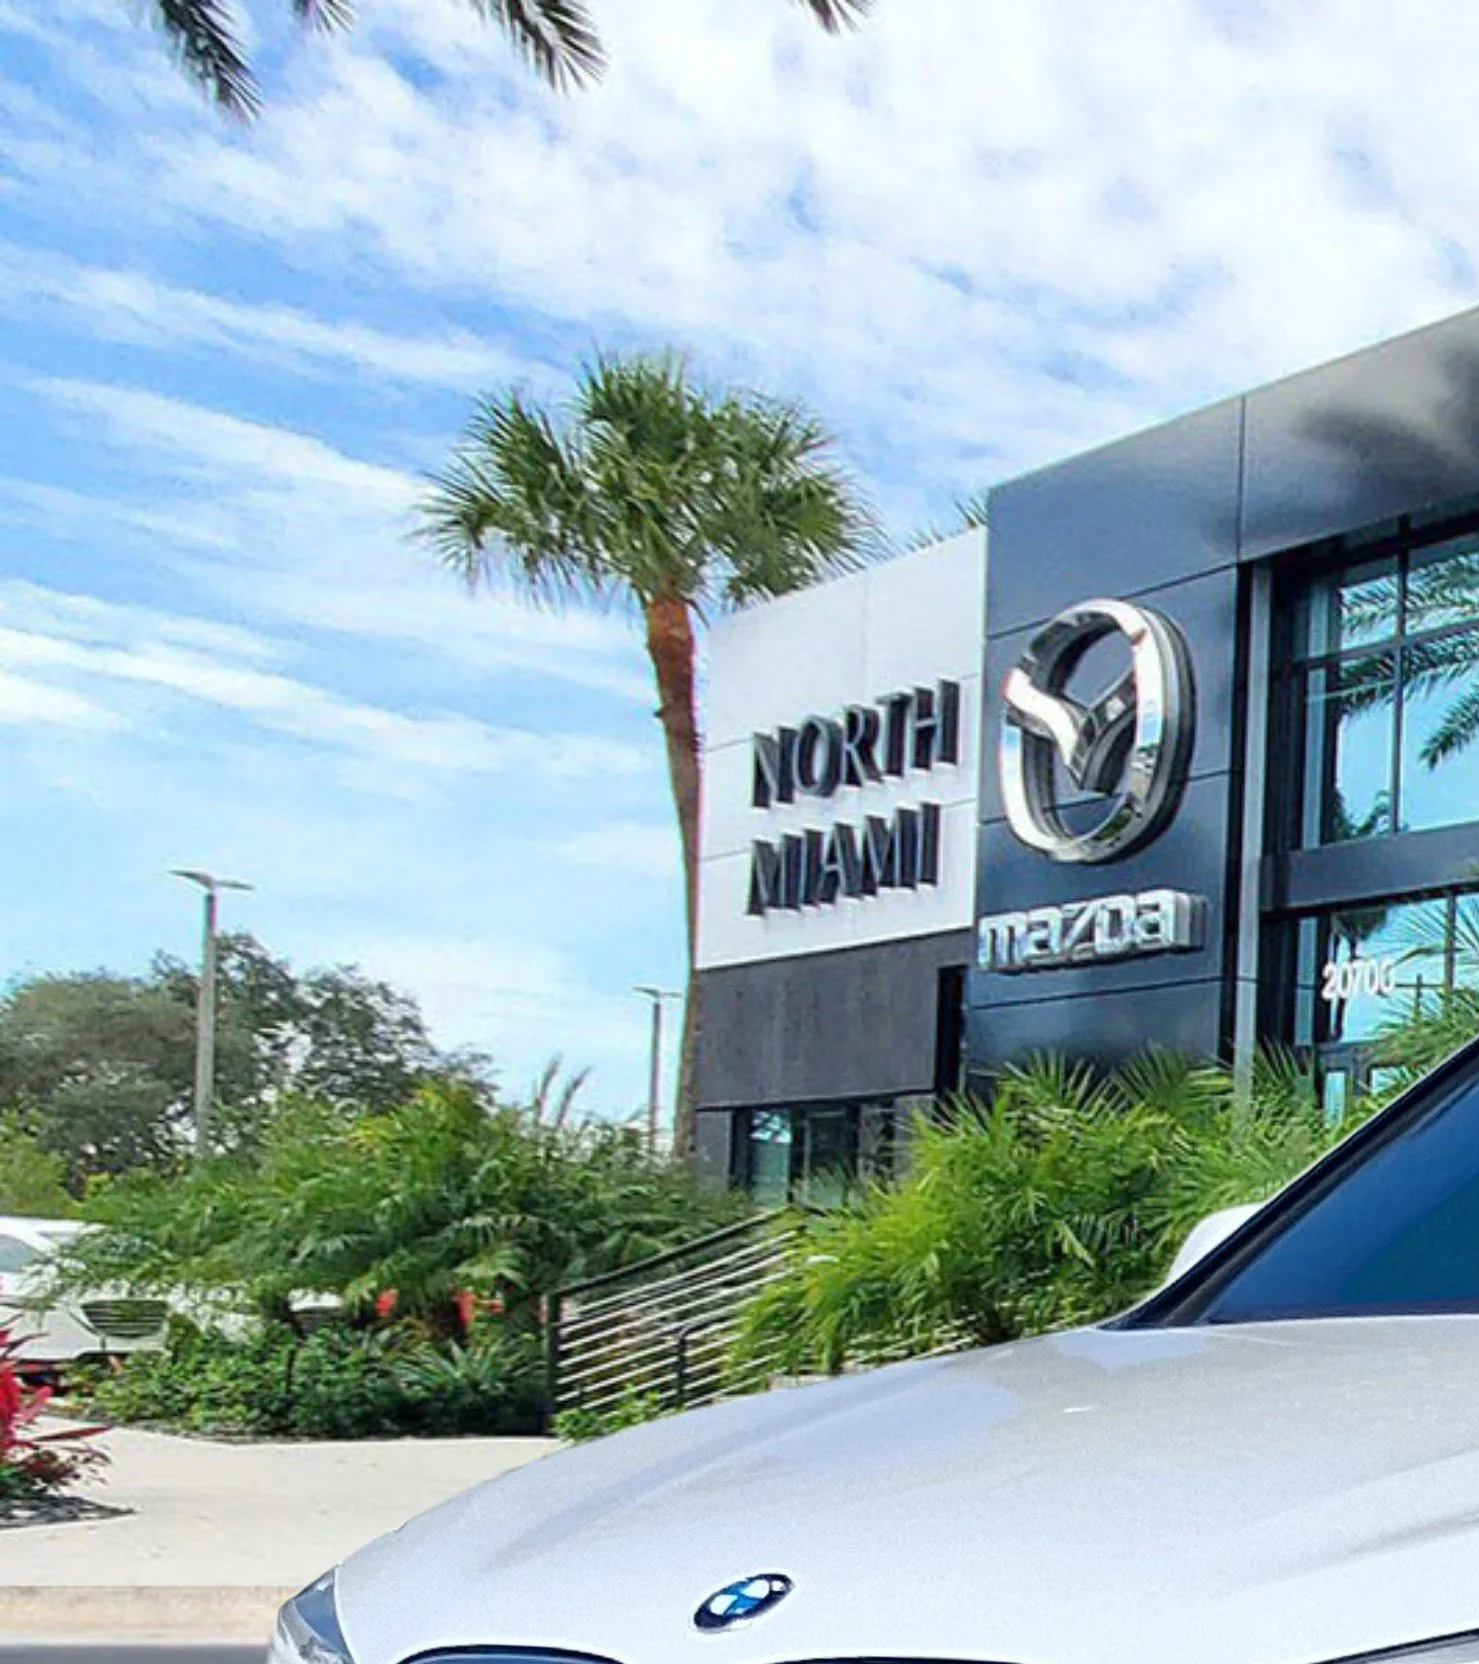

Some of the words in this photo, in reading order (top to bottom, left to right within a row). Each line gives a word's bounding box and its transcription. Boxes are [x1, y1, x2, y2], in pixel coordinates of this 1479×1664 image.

[752, 679, 960, 808] NORTH
[746, 802, 940, 915] MIAMI
[978, 889, 1202, 973] mazda
